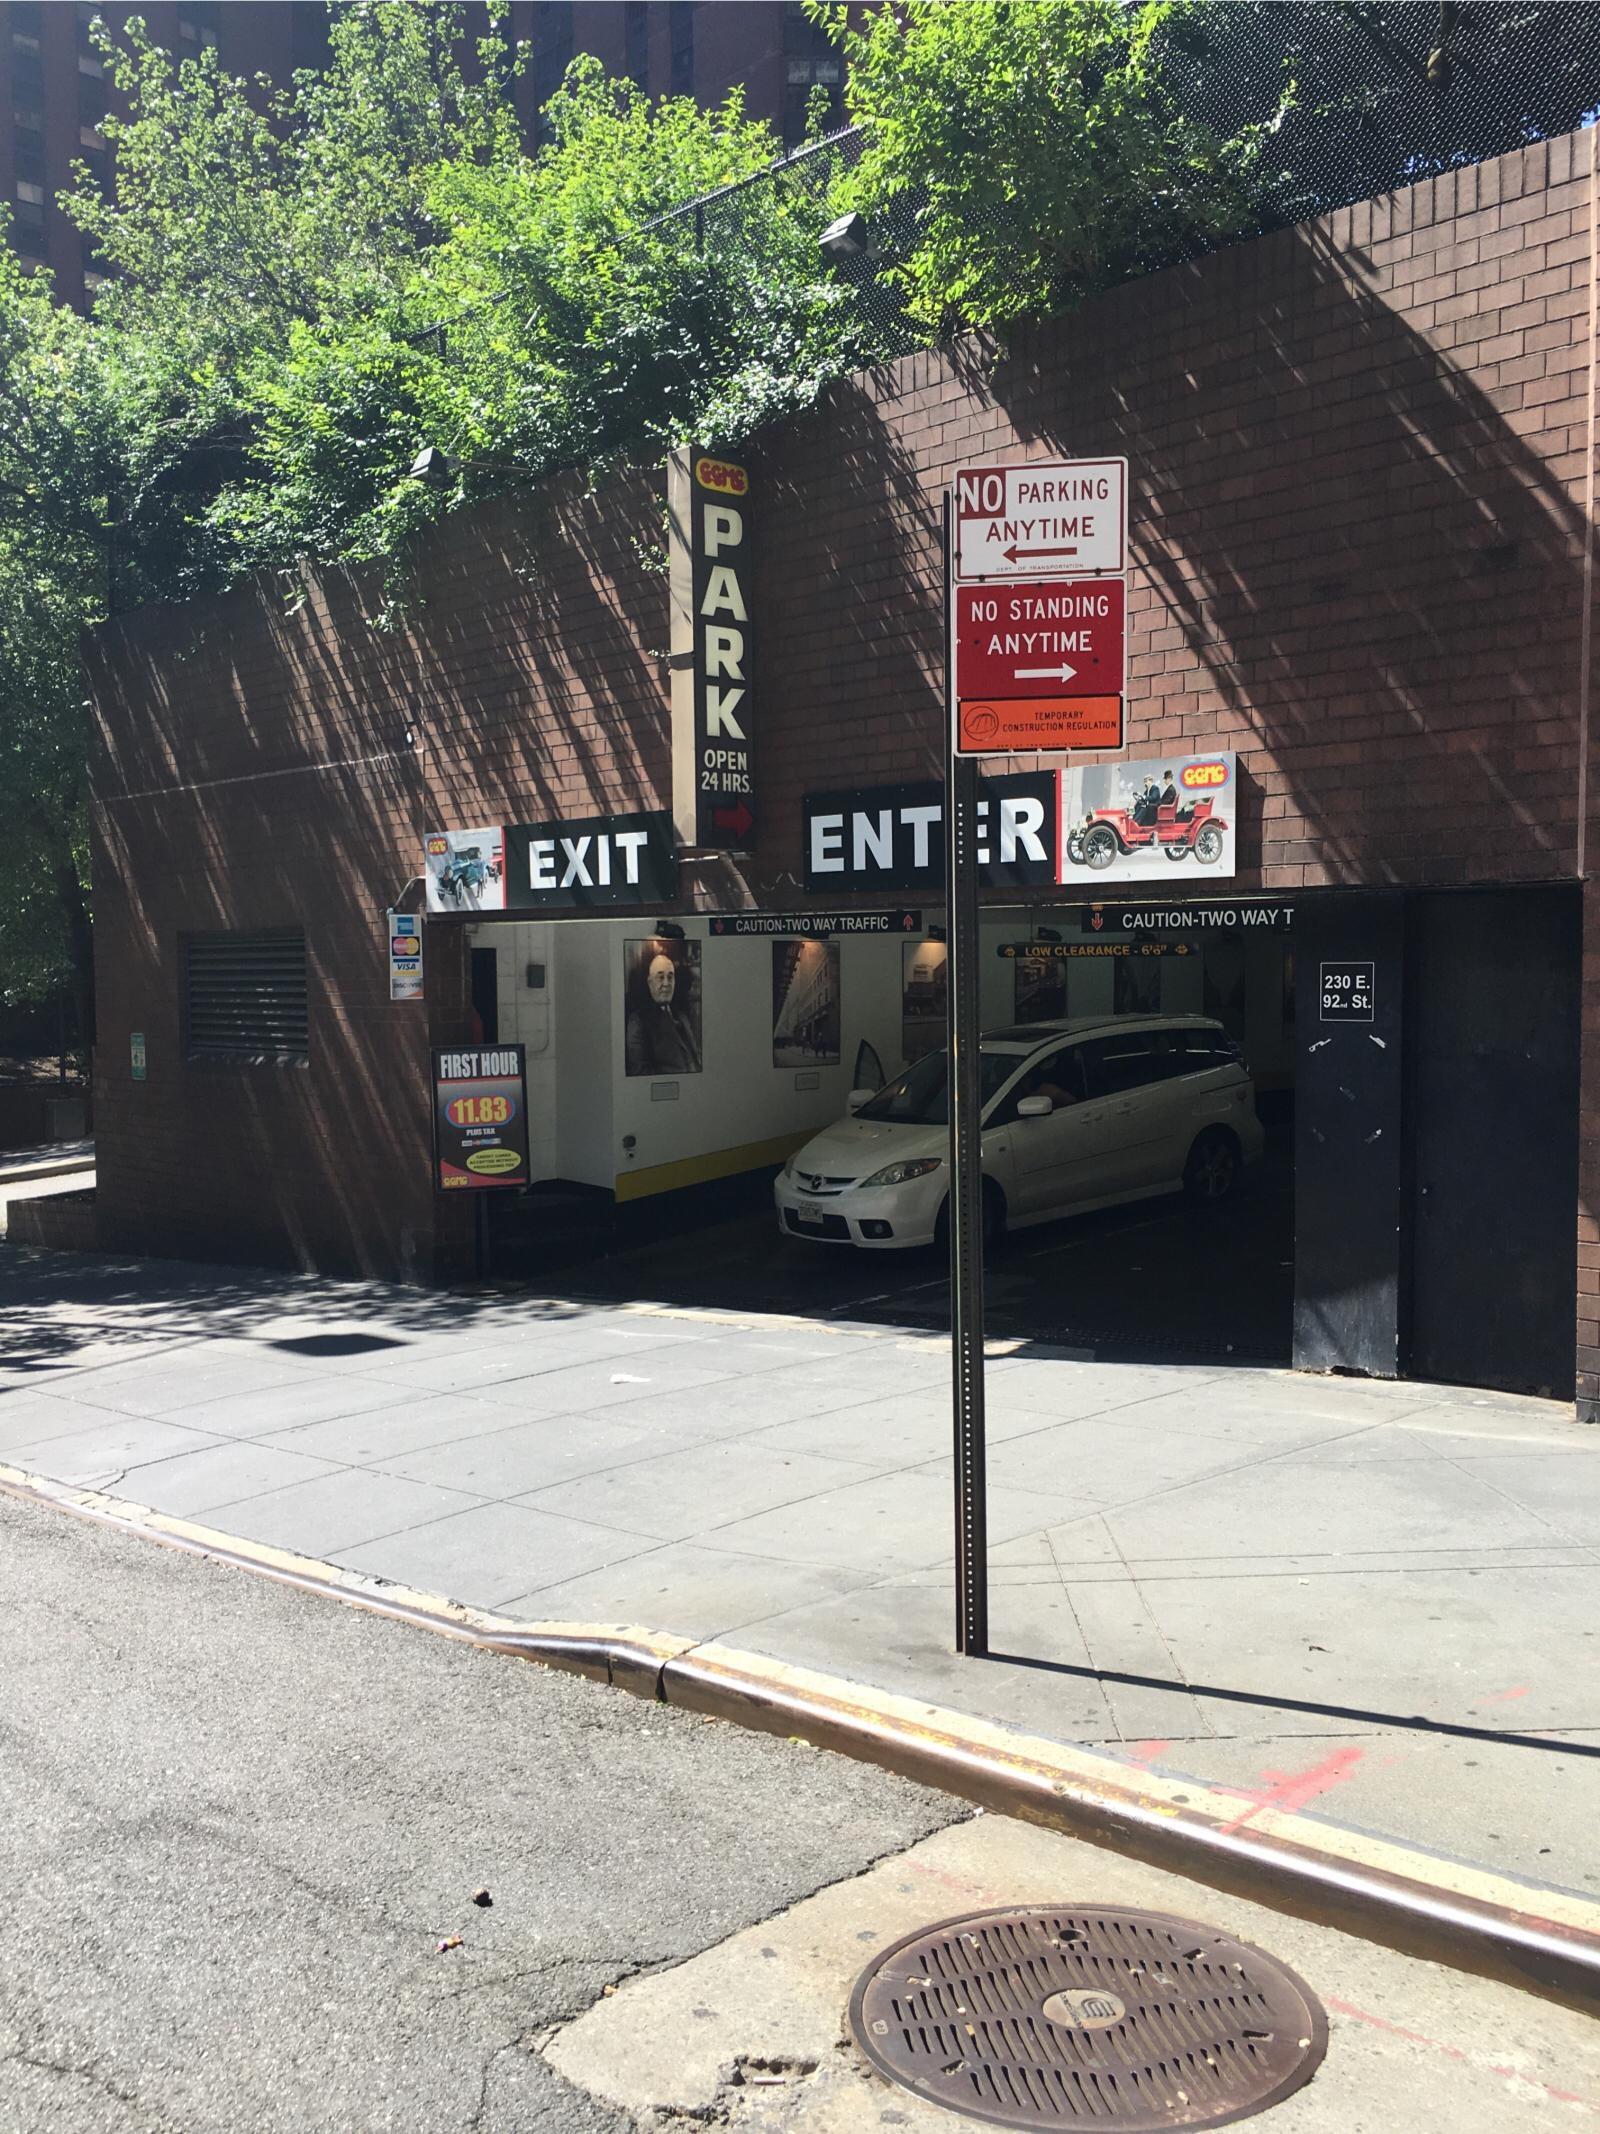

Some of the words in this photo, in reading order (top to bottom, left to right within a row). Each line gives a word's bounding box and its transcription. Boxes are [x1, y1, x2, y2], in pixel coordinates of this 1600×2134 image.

[959, 474, 1003, 514] NO
[1018, 478, 1109, 504] PARKING
[986, 516, 1095, 543] ANYTIME
[971, 600, 998, 622] NO
[1009, 595, 1109, 621] STANDING
[700, 503, 749, 740] PARK
[987, 630, 1092, 656] ANYTIME
[1002, 722, 1064, 733] CONSTRUCTION
[1066, 720, 1117, 731] REGULATION
[1034, 710, 1085, 721] TEMPORARY
[704, 749, 747, 771] OPEN
[701, 771, 719, 791] 24
[722, 772, 753, 794] HRS.
[529, 831, 648, 890] EXIT
[735, 918, 811, 932] CAUTION-TWO
[812, 917, 837, 931] WAY
[839, 916, 889, 930] TRAFFIC
[1122, 910, 1237, 929] CAUTION-TWO
[1241, 909, 1279, 926] WAY
[1025, 946, 1051, 957] LOW
[1054, 945, 1130, 957] CLEARANCE
[1325, 975, 1350, 989] 230
[1356, 975, 1370, 989] E.
[1352, 994, 1371, 1009] St.
[440, 1053, 479, 1079] FIRST
[481, 1051, 518, 1077] HOUR
[454, 1096, 507, 1124] 11.83
